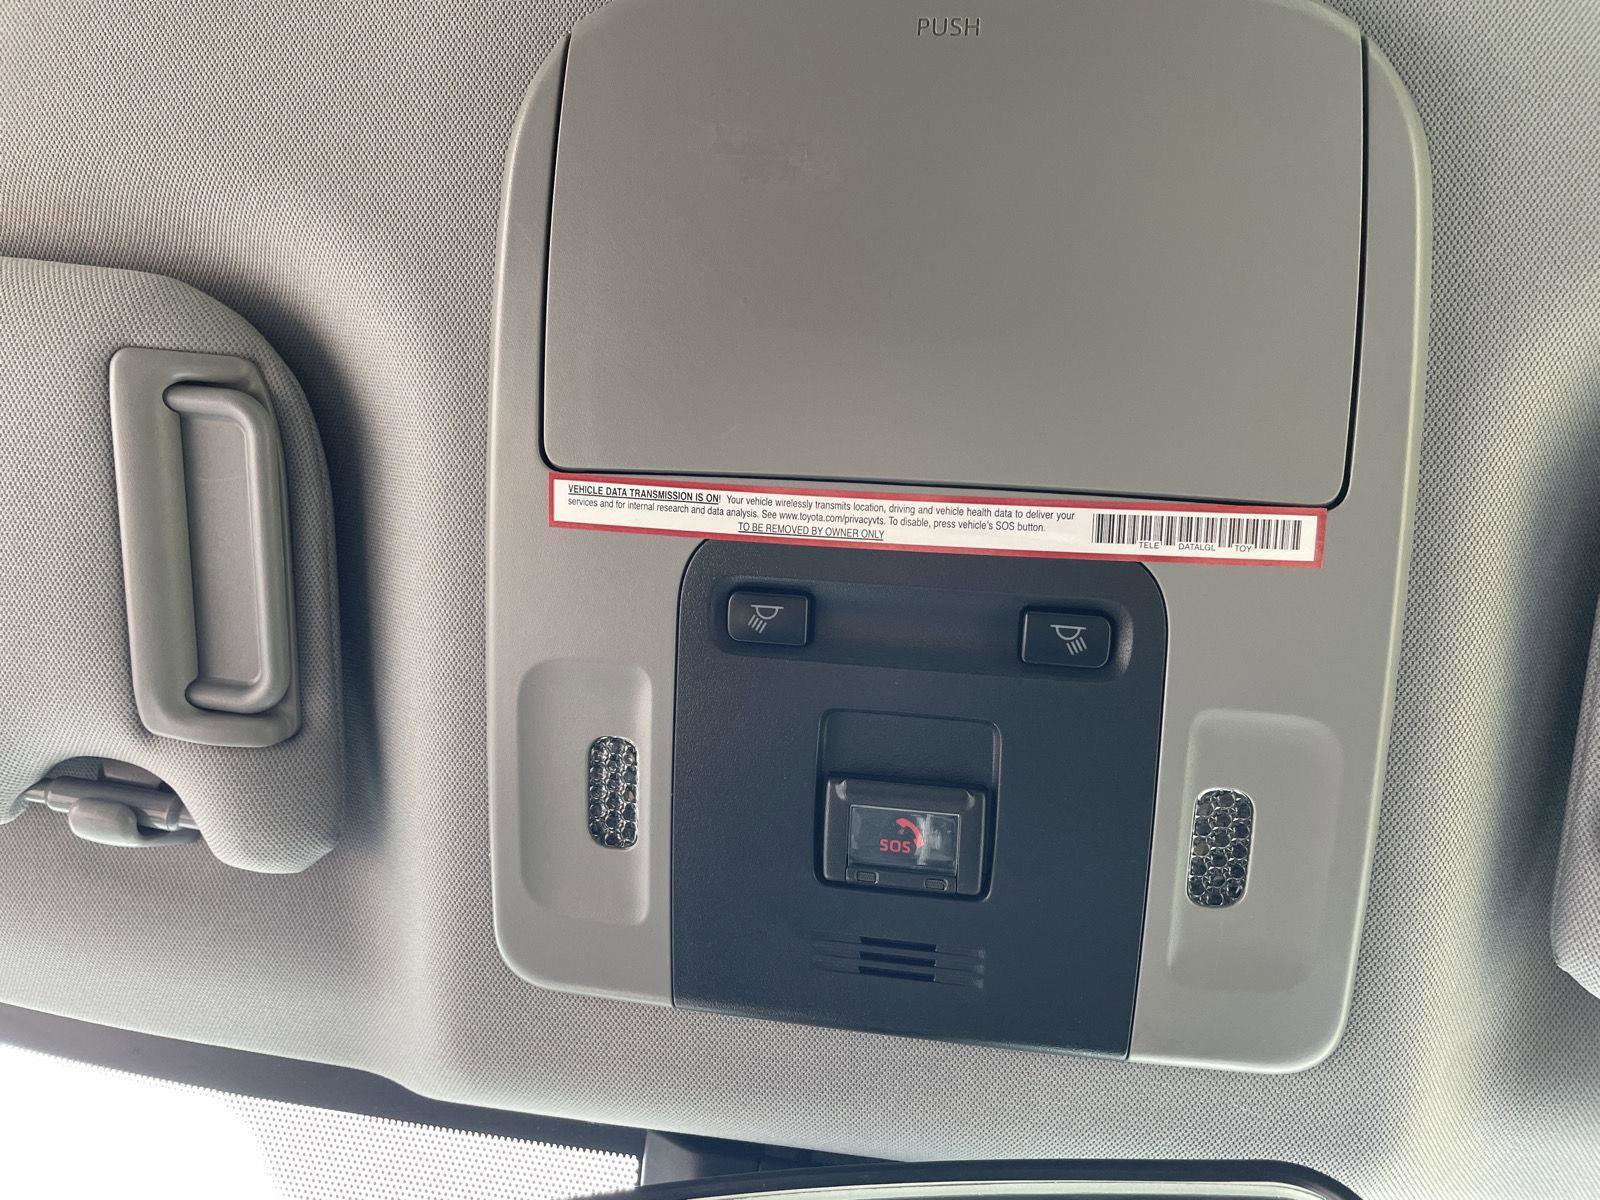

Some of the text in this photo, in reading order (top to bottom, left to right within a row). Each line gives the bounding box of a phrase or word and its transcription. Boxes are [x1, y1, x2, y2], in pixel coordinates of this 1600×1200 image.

[917, 17, 980, 36] PUSH
[568, 484, 603, 495] VEHICLE
[605, 486, 627, 497] DATA
[629, 488, 693, 501] TRANSMISSION
[695, 493, 704, 501] IS
[727, 495, 744, 504] Your
[746, 496, 772, 506] vehicle
[775, 498, 813, 511] wirelessly
[815, 501, 851, 511] transmits
[853, 502, 886, 513] location,
[889, 503, 915, 516] driving
[918, 505, 933, 515] and
[936, 506, 964, 516] vehicle
[967, 507, 992, 517] health
[995, 509, 1012, 518] data
[1015, 510, 1024, 519] to
[1026, 509, 1053, 519] deliver
[1056, 512, 1075, 521] your
[568, 497, 598, 507] services
[600, 499, 614, 508] and
[616, 500, 625, 509] for
[628, 501, 655, 511] internal
[657, 503, 689, 514] research
[691, 505, 705, 515] and
[707, 506, 724, 516] data
[726, 508, 759, 519] analysis.
[762, 509, 777, 519] See
[889, 516, 898, 526] To
[900, 518, 931, 529] disable,
[933, 520, 956, 530] press
[958, 520, 994, 530] vehicle's
[995, 521, 1015, 531] SOS
[1017, 522, 1046, 532] button.
[738, 522, 885, 539] TO BE REMOVED BY OWNER ONLY
[1139, 541, 1160, 550] TELE
[1234, 544, 1252, 553] TOY
[879, 838, 911, 854] SOS
